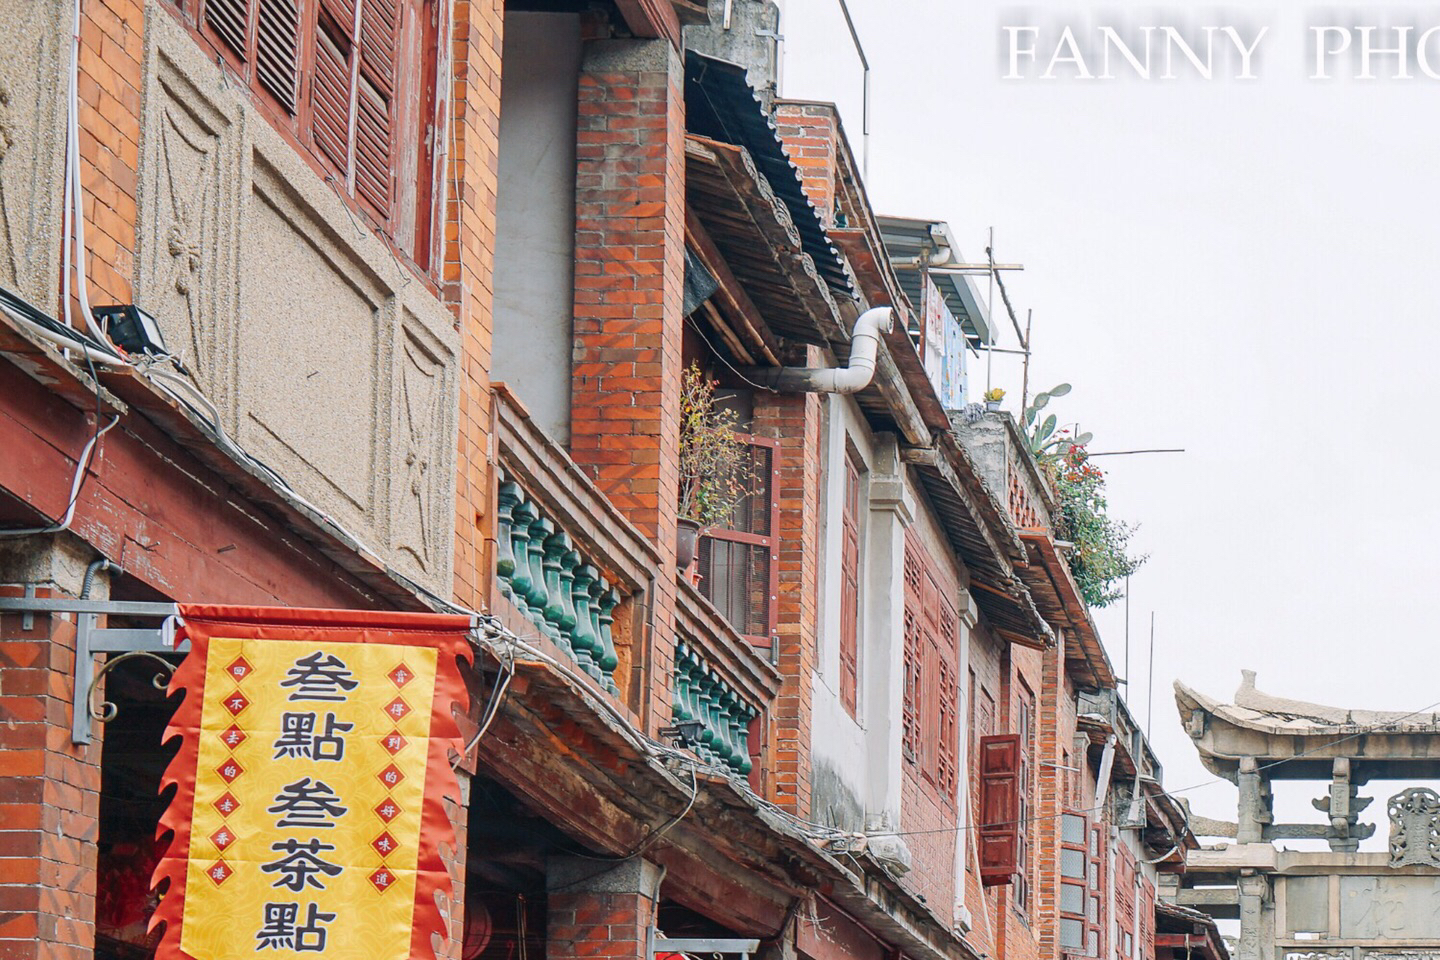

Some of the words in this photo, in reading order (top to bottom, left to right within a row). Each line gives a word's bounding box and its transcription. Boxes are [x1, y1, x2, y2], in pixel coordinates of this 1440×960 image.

[211, 664, 250, 882] 回不去的老香港
[255, 650, 360, 953] 叁點叁茶點
